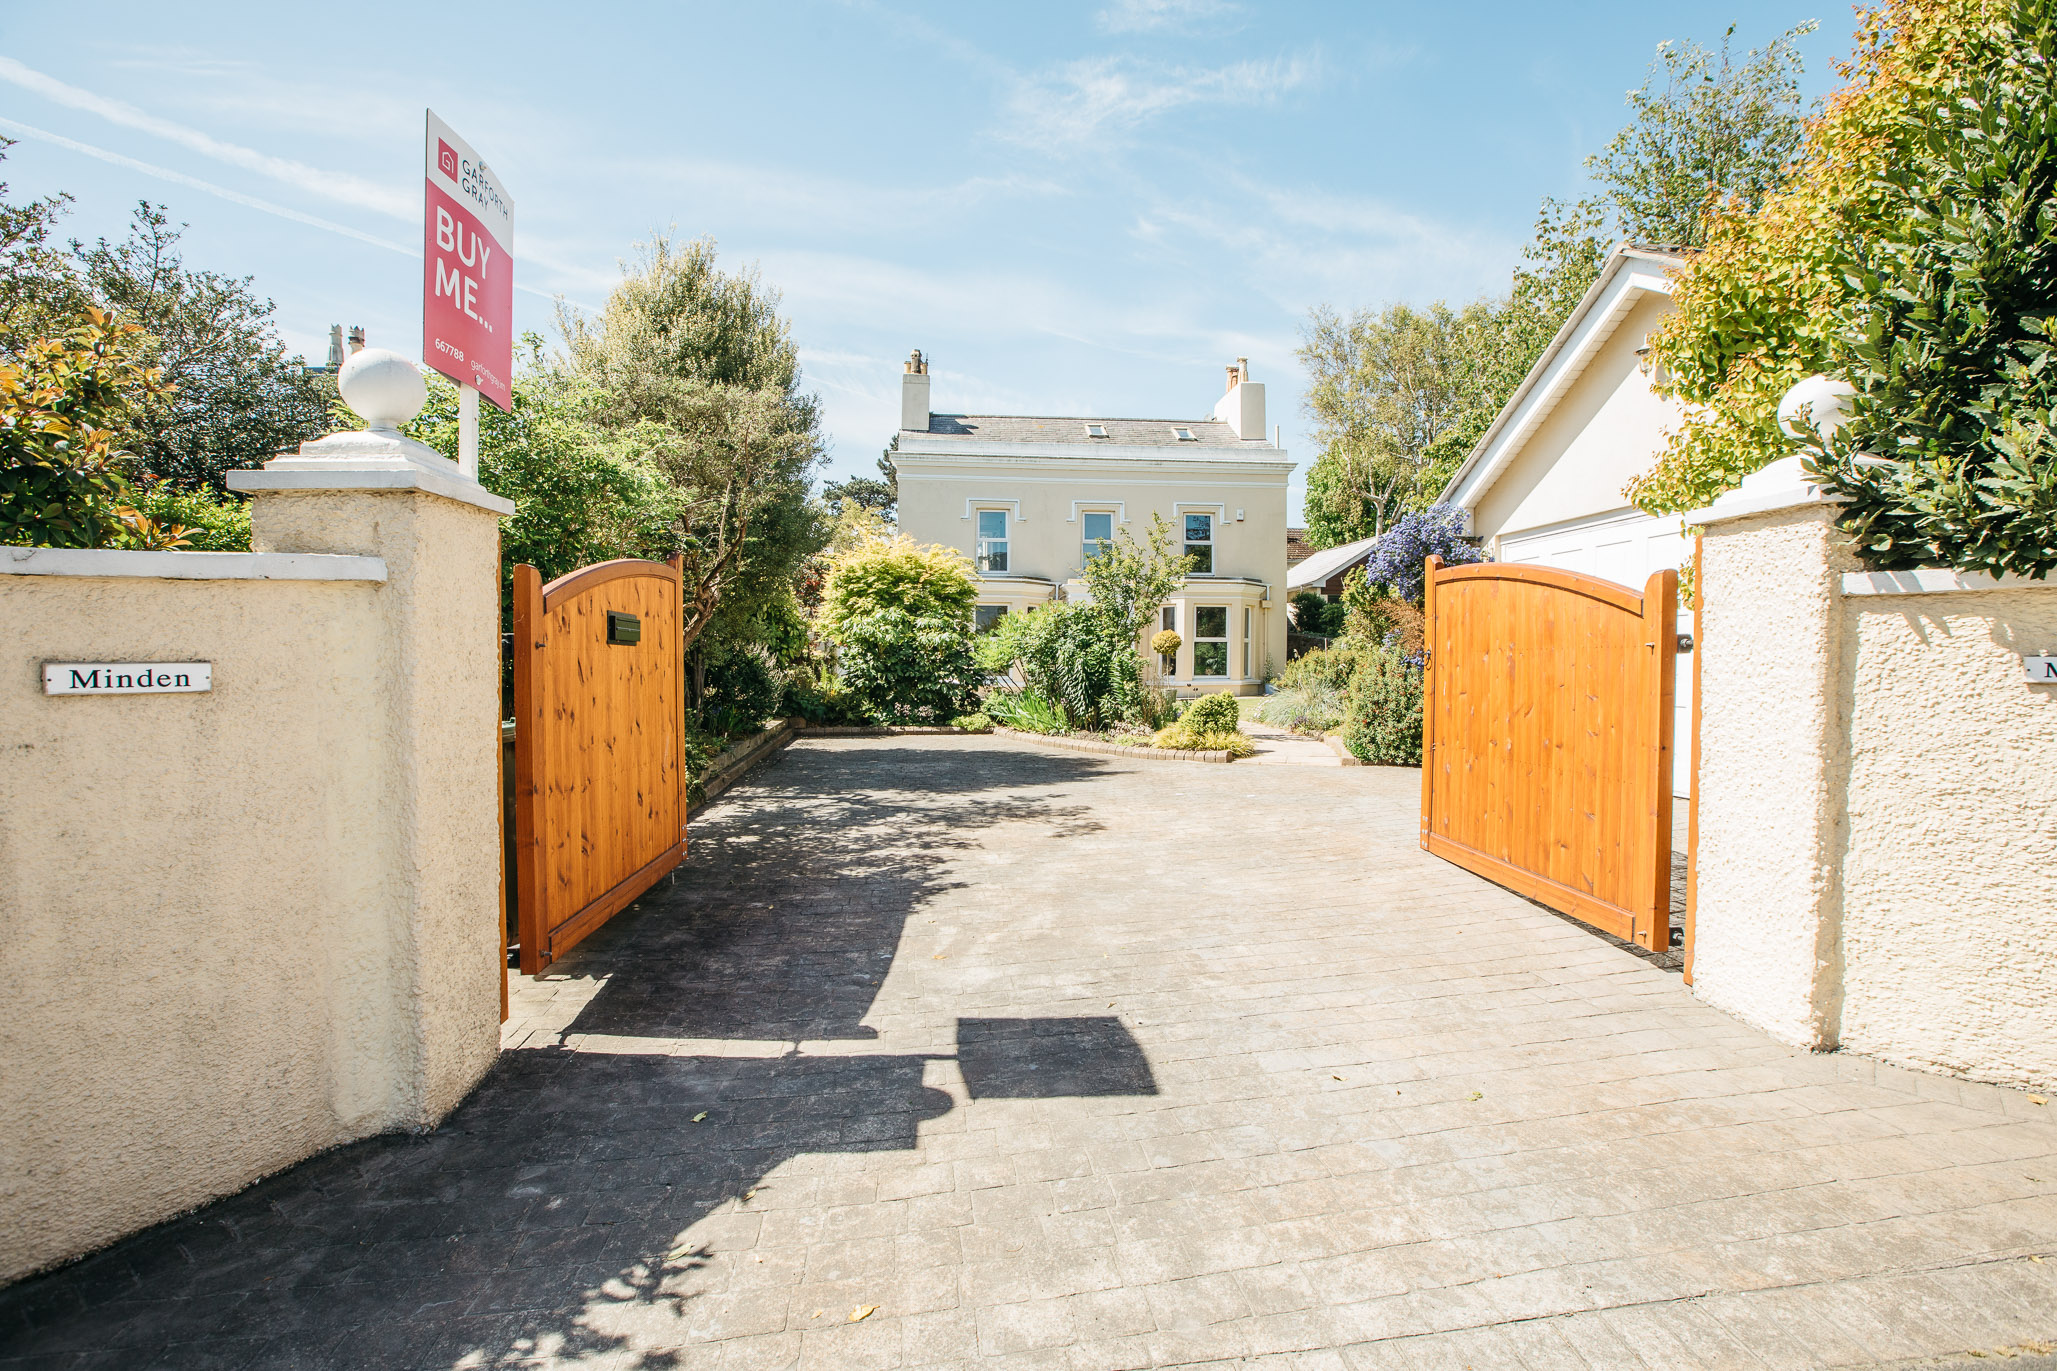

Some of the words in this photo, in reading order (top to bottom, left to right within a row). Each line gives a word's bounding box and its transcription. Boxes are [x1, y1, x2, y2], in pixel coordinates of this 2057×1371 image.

[462, 160, 508, 221] GARFORTH
[462, 178, 489, 211] GRAY
[436, 205, 490, 280] BUY
[435, 257, 493, 333] ME...
[435, 338, 464, 362] 667788
[69, 669, 191, 689] Minden
